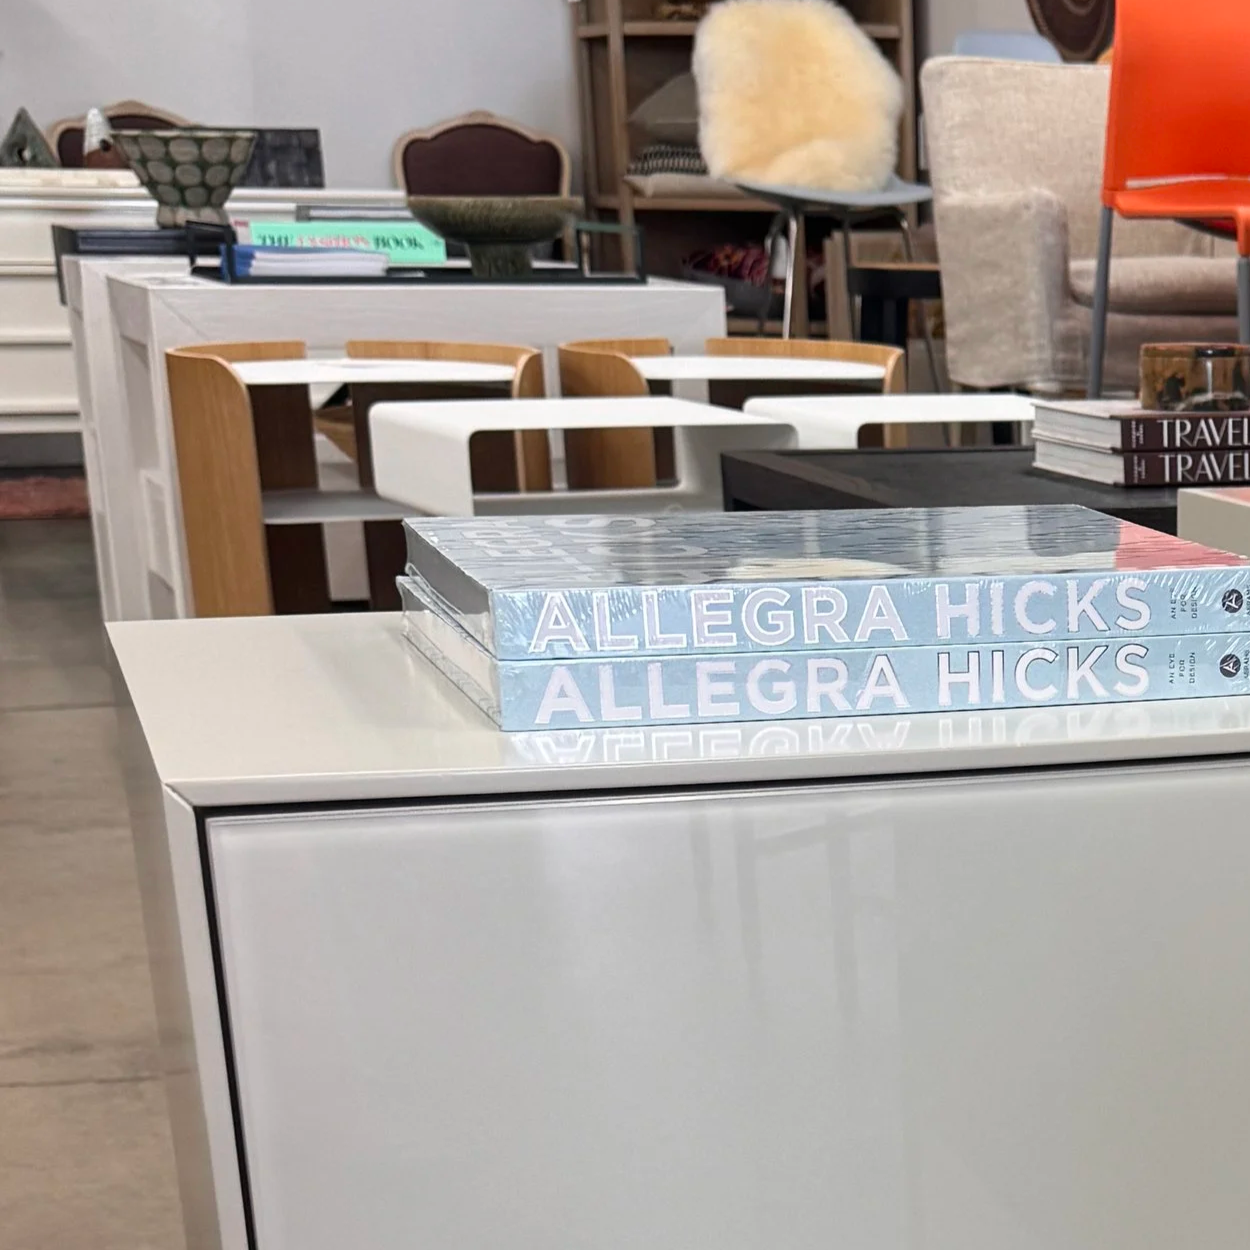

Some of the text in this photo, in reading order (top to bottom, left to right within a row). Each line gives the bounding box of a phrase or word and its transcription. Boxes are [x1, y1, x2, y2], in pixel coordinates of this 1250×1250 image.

[373, 234, 424, 250] BOOK
[528, 578, 1151, 653] ALLEGRA HICKS
[534, 643, 1150, 724] ALLEGRA HICKS
